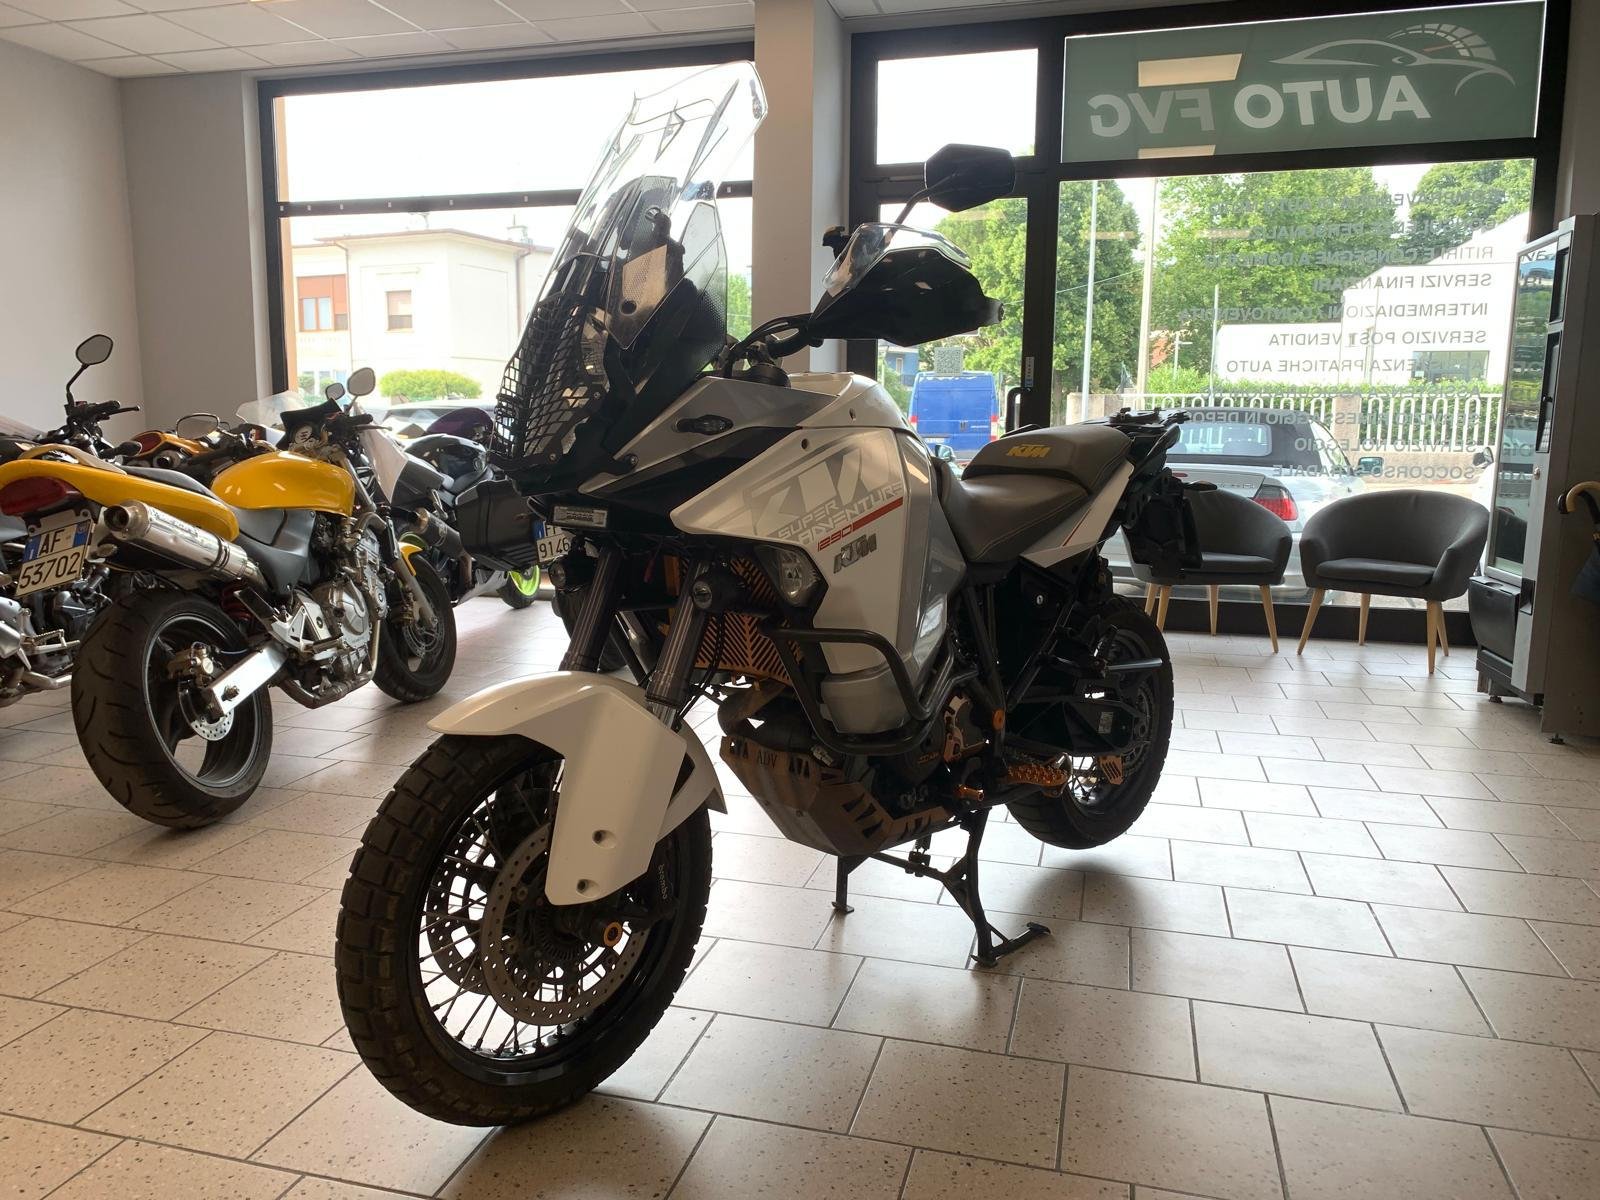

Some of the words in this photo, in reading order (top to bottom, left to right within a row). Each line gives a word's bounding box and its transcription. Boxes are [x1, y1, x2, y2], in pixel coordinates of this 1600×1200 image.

[1006, 444, 1052, 458] KTM
[777, 499, 840, 539] SUPER
[39, 528, 66, 555] AF
[817, 523, 854, 552] 1290
[833, 533, 877, 574] KTM
[19, 551, 81, 589] 53702
